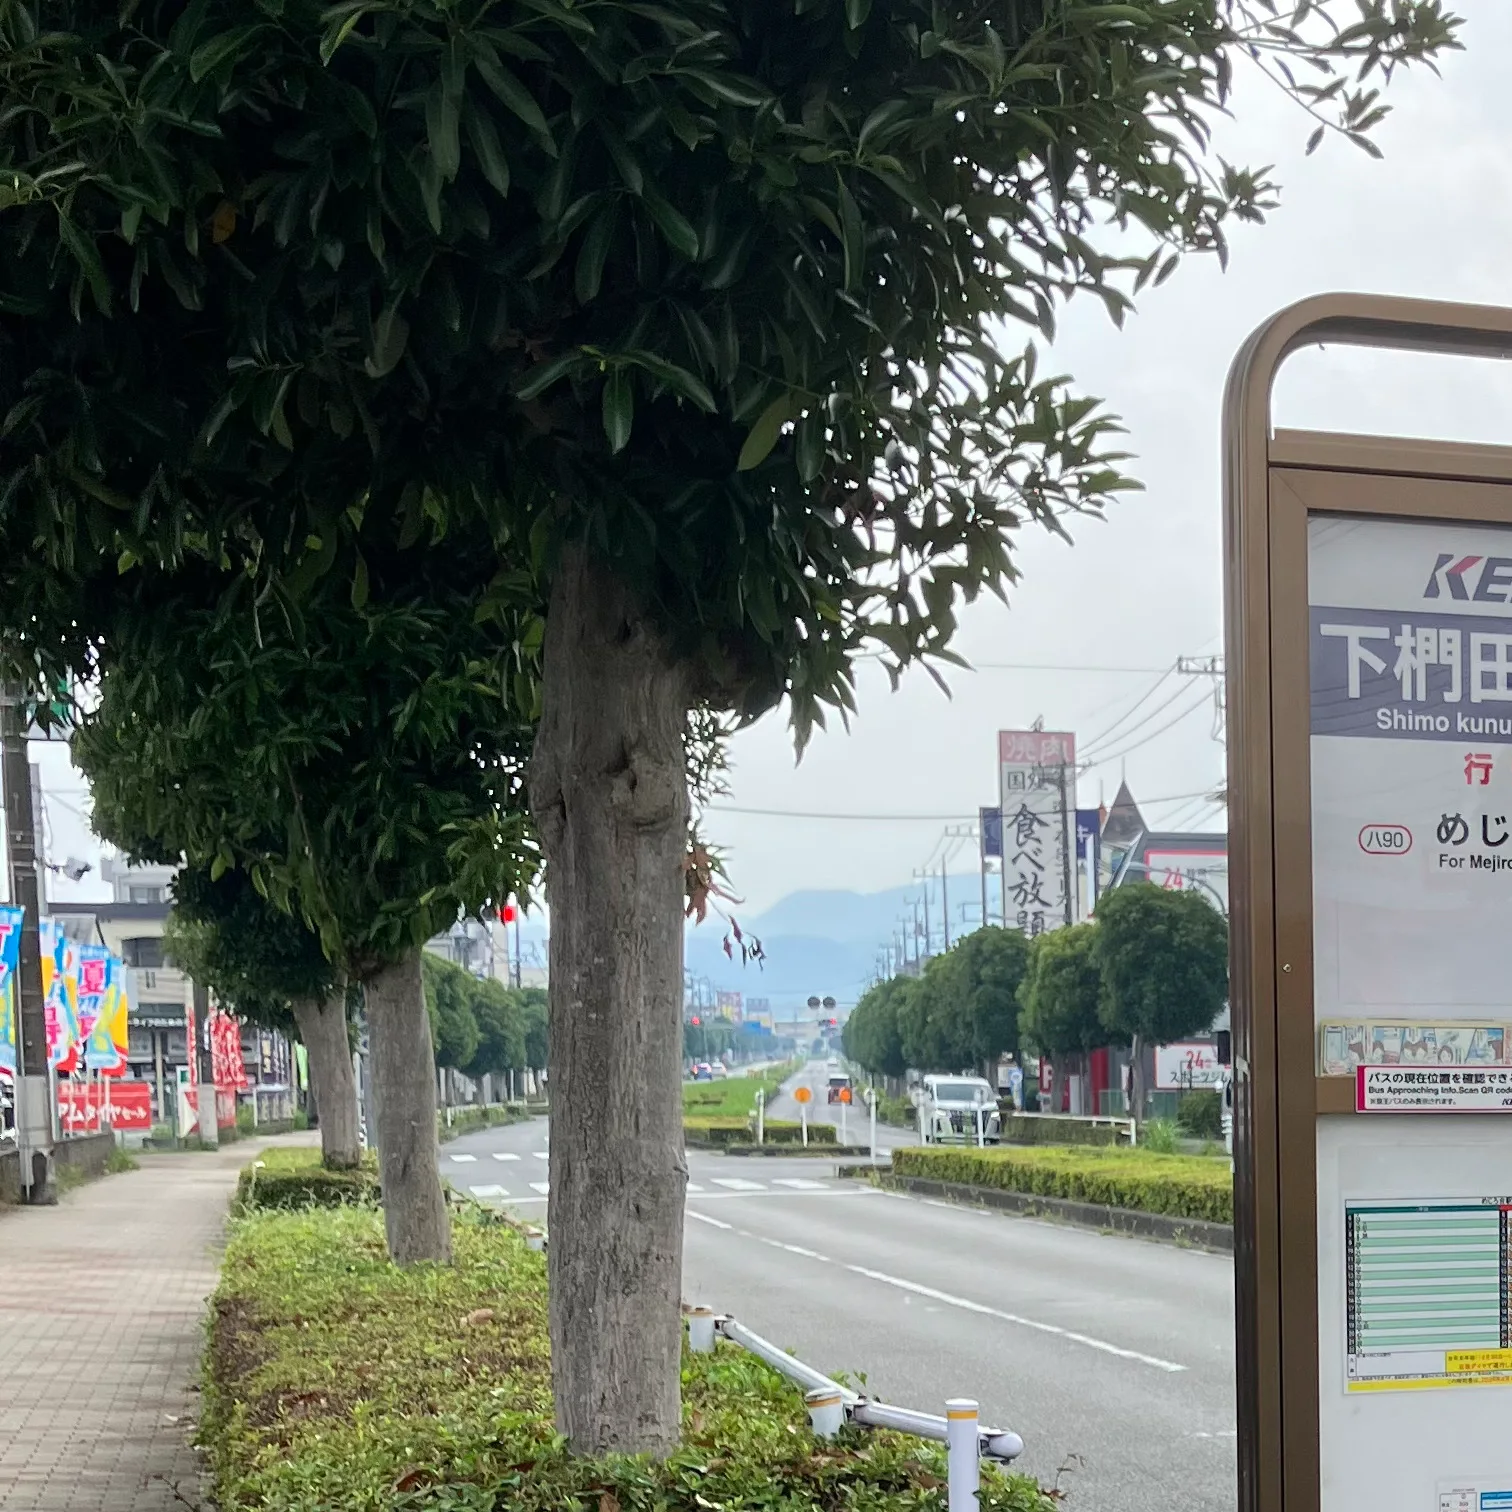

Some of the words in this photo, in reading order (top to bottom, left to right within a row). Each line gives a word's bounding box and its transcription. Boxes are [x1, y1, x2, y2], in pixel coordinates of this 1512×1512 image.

[1377, 708, 1450, 732] Shimo
[1006, 735, 1070, 761] 焼肉
[1007, 803, 1052, 935] 食べ放題
[1439, 854, 1465, 869] For
[1163, 867, 1182, 888] 24
[1186, 1050, 1203, 1070] 24
[1369, 1087, 1384, 1095] Bus
[1387, 1087, 1439, 1095] Approaching
